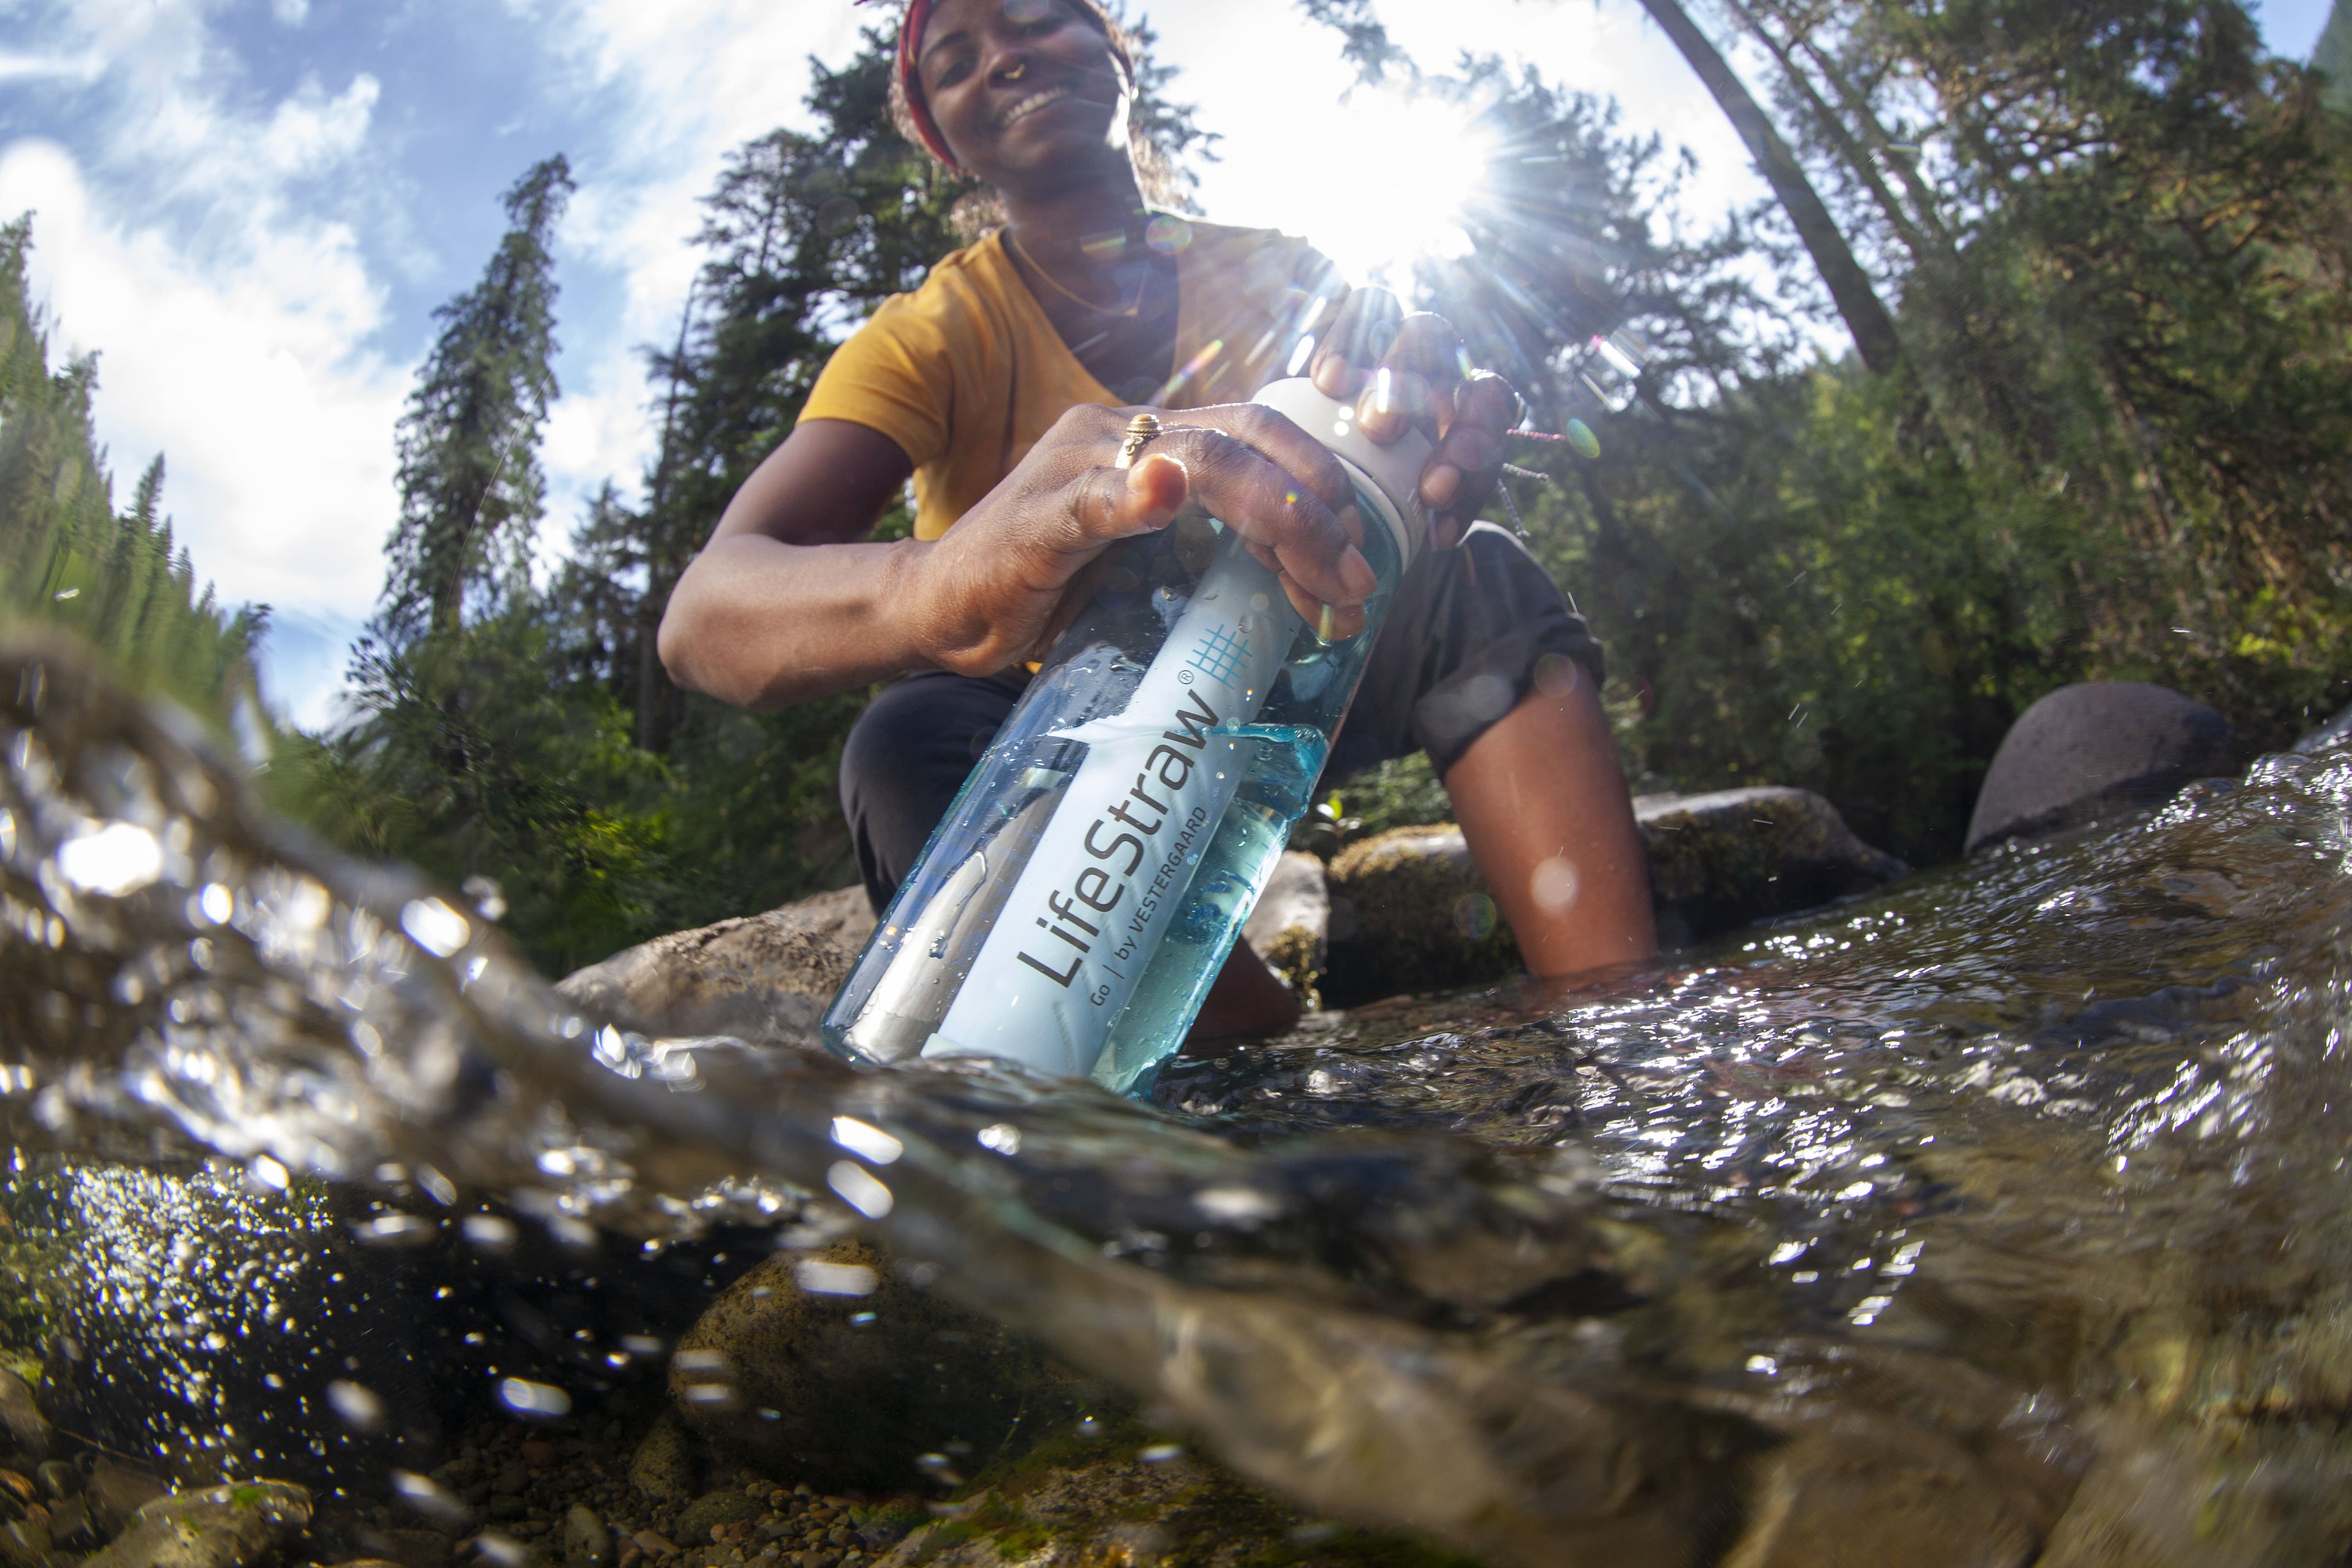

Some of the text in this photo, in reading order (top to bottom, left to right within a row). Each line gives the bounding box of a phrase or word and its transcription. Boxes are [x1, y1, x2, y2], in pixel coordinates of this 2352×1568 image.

[1090, 985, 1110, 1006] Go
[1115, 936, 1137, 960] by
[1129, 807, 1207, 933] VESTERGAARD
